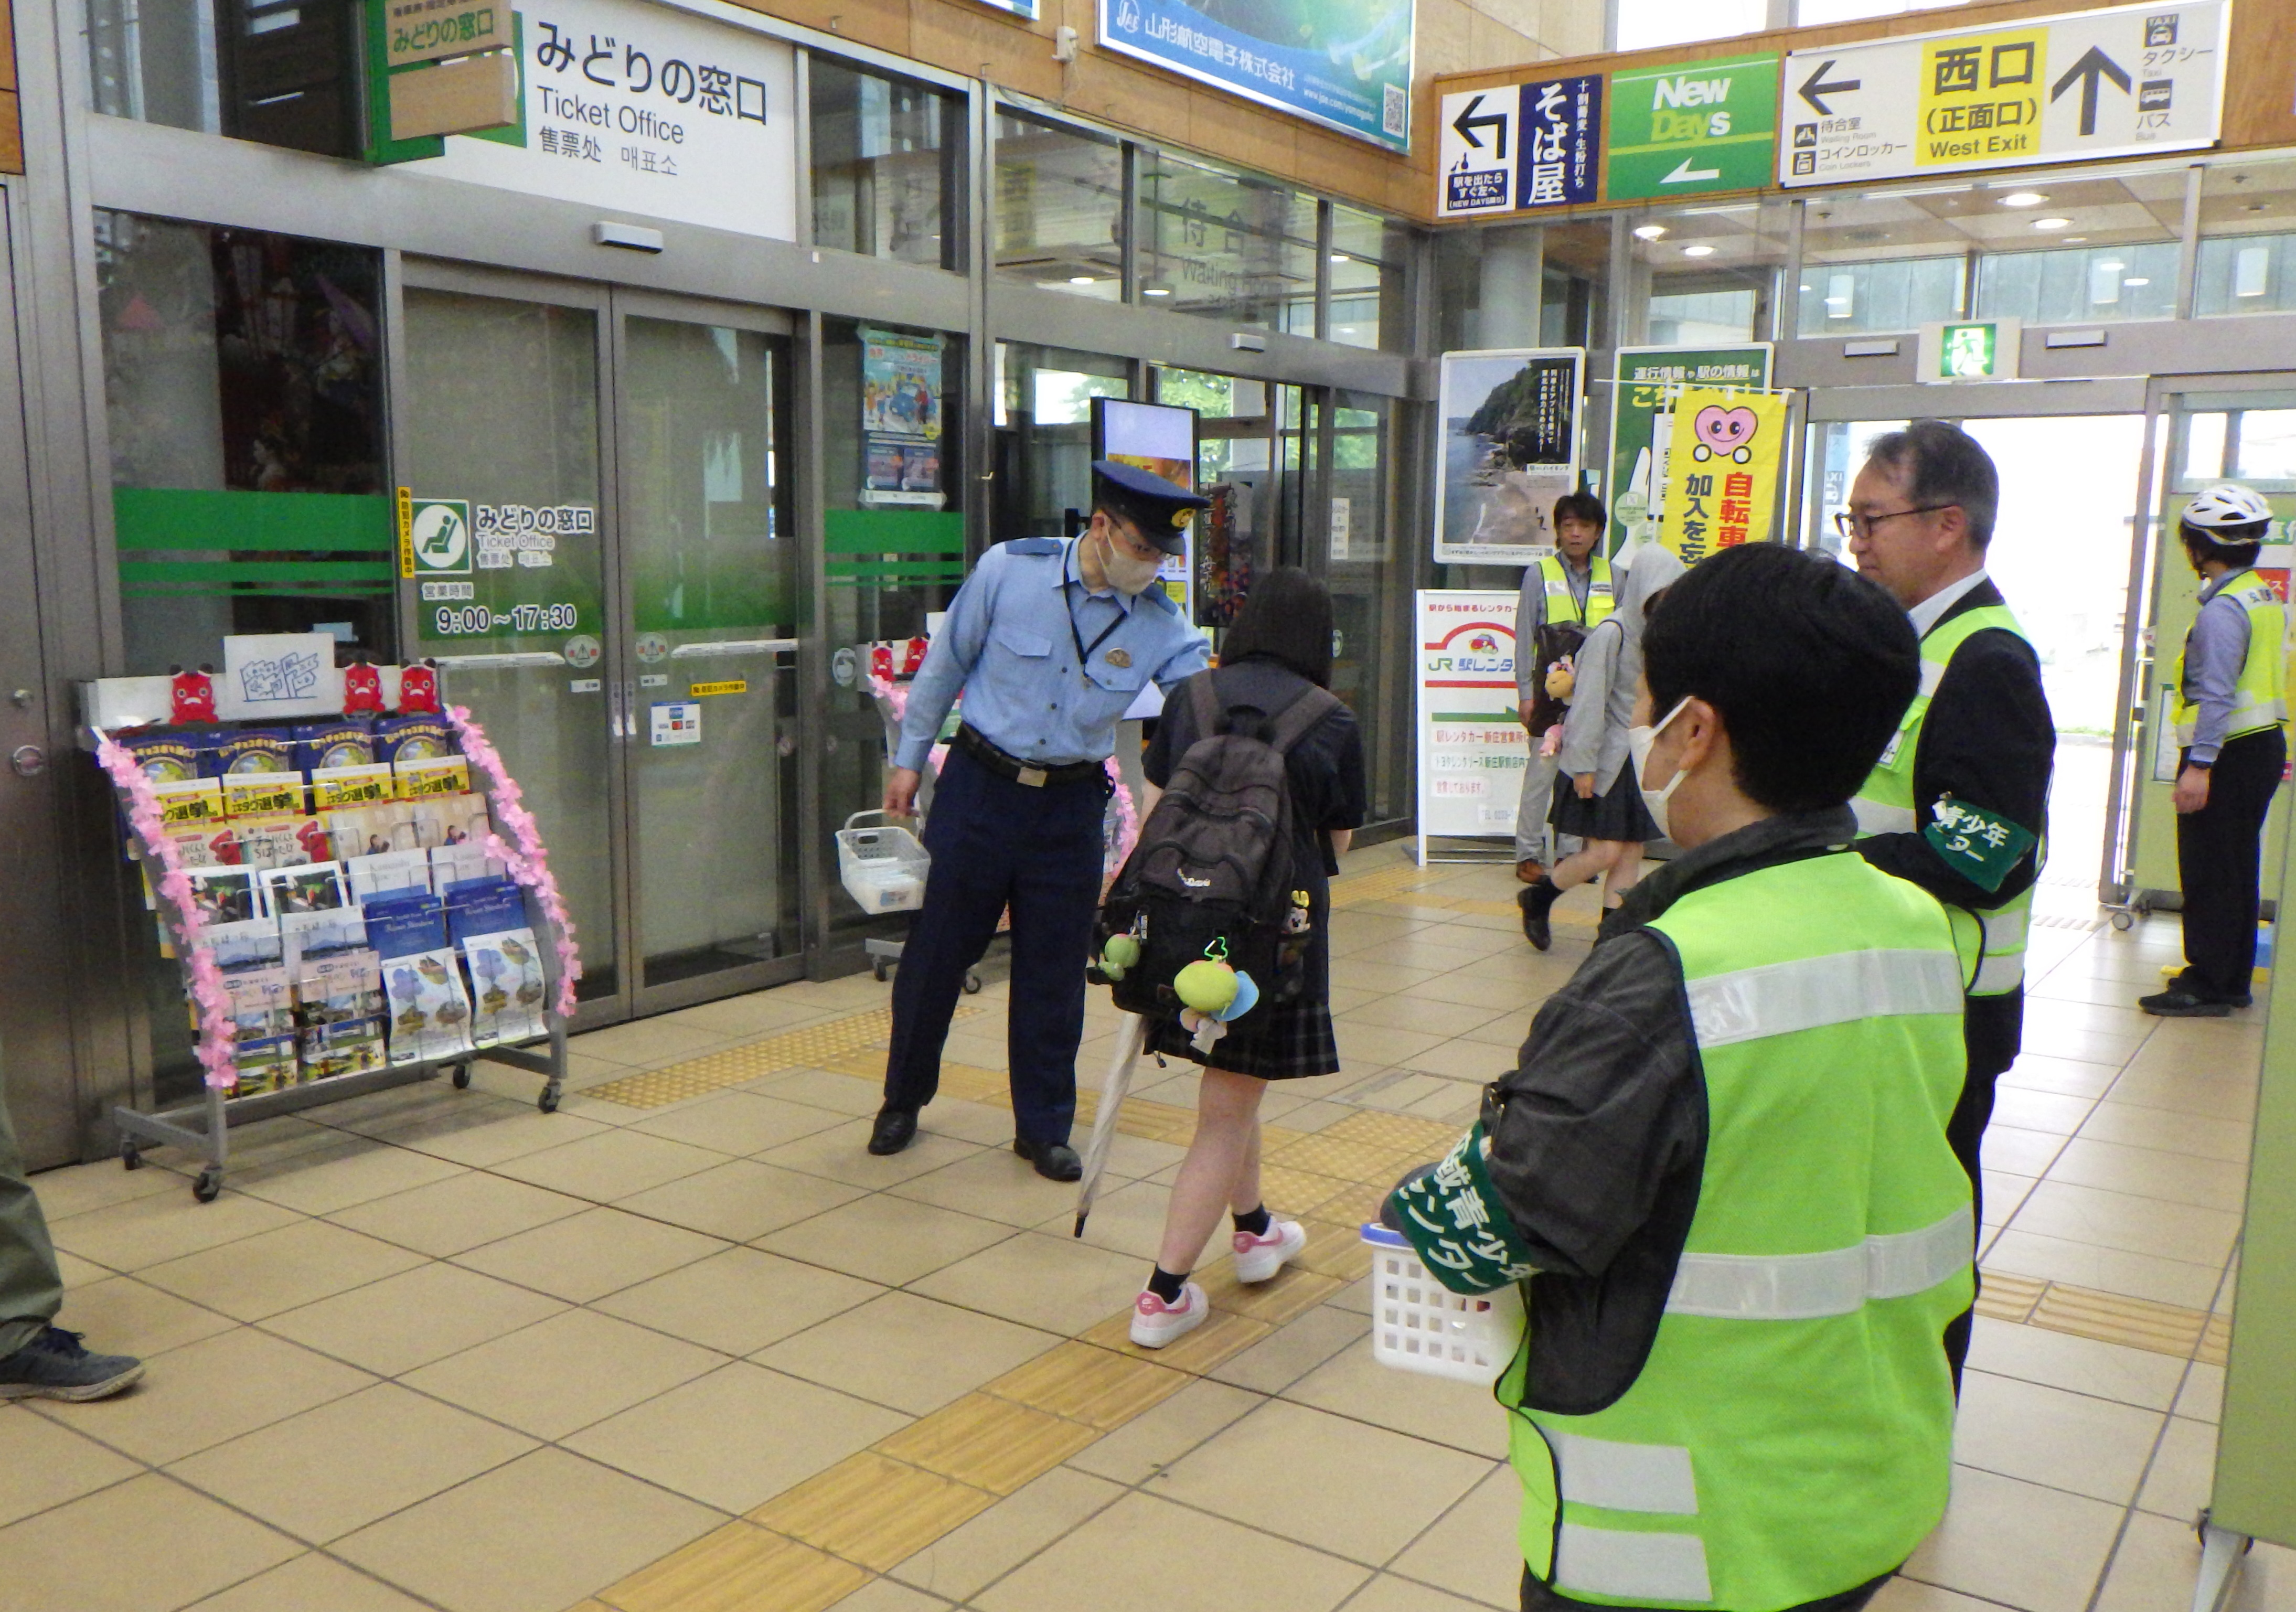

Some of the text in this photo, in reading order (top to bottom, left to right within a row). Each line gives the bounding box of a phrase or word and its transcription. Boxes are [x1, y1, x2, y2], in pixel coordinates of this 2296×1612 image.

[394, 9, 494, 52] みどりの窓口
[1145, 13, 1295, 90] 山形航空電子株式会社
[2142, 48, 2214, 67] タクシー
[537, 22, 767, 125] みどりの窓口
[1934, 41, 2036, 95] 西口
[1652, 76, 1731, 110] New
[537, 86, 685, 144] Ticket Office
[1651, 111, 1731, 142] Days
[1821, 117, 1861, 133] 待合室
[2137, 113, 2171, 130] バス
[539, 126, 602, 163] 售票处
[1528, 82, 1569, 205] そば屋
[1819, 142, 1908, 161] コインロッカー
[1821, 134, 1850, 144] Waiting
[1930, 134, 2027, 159] West Exit
[621, 146, 678, 176] 매표소
[478, 507, 592, 531] みどりの窓口
[1716, 472, 1754, 548] 自転車
[478, 534, 553, 548] Ticket Office
[424, 584, 473, 599] 営業時間
[1428, 657, 1517, 672] JR 駅レンタ
